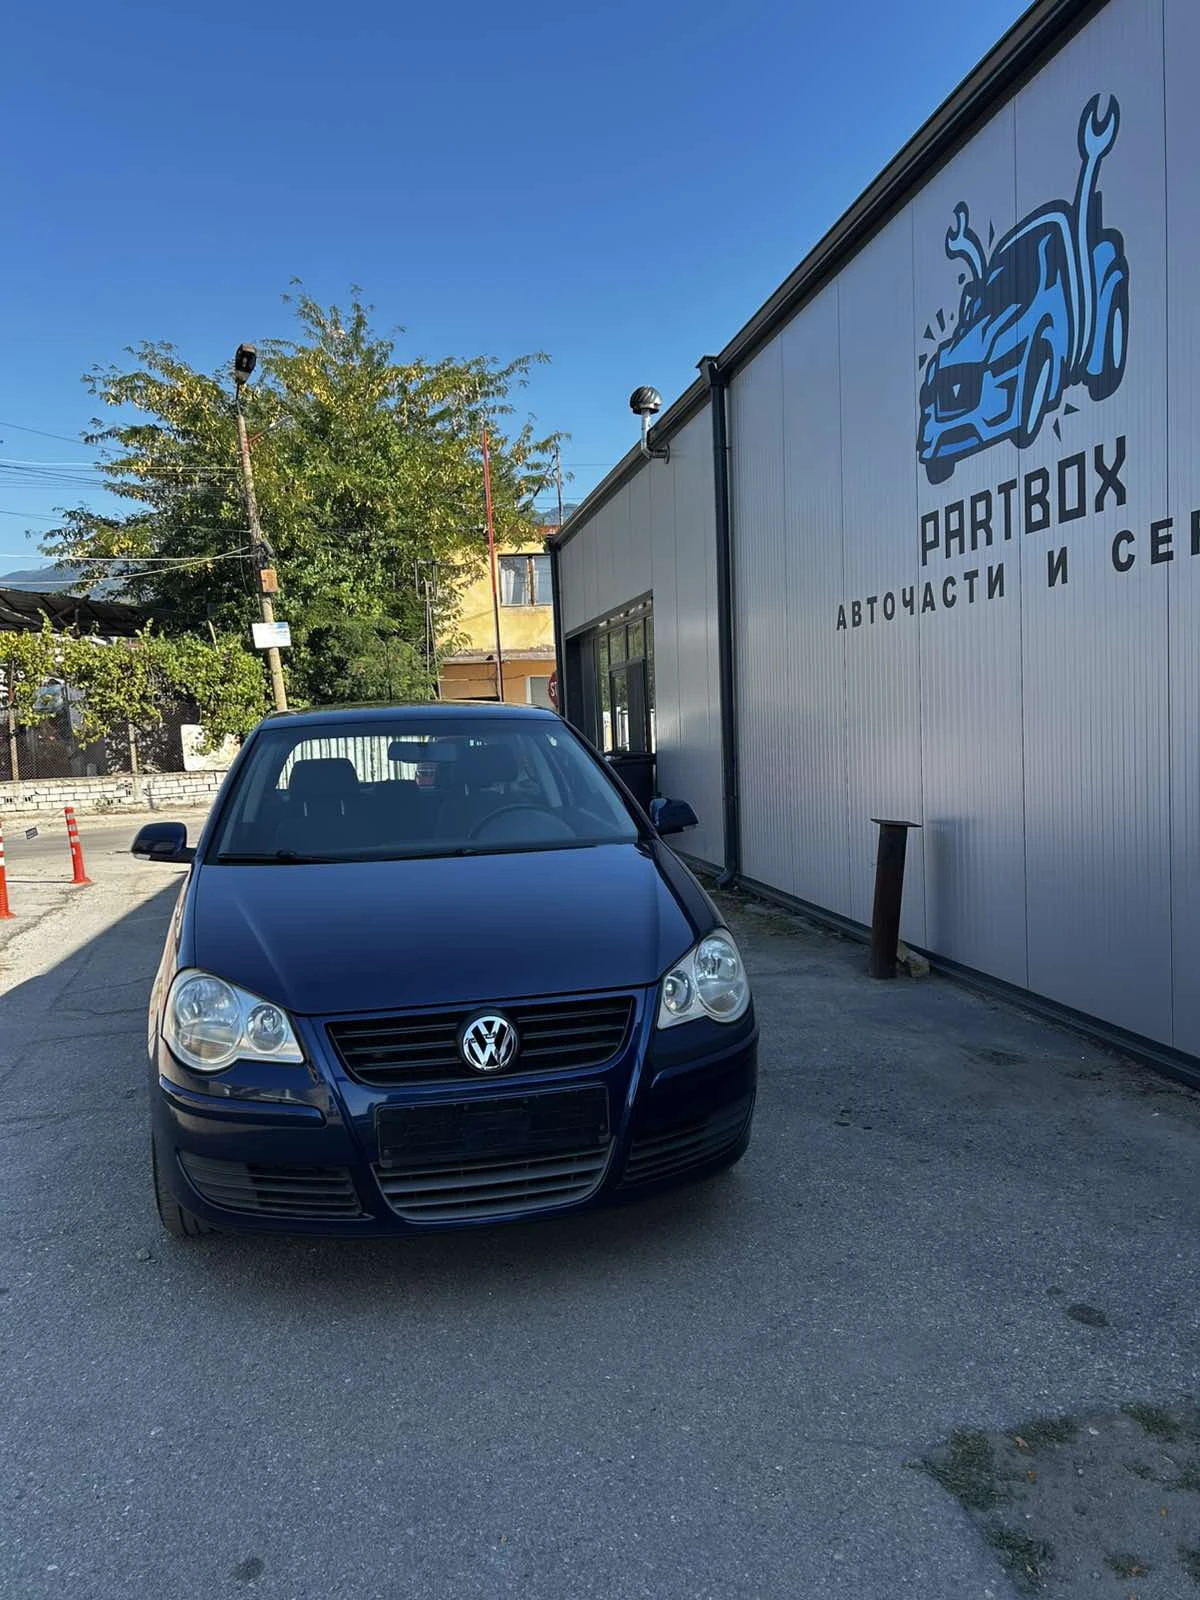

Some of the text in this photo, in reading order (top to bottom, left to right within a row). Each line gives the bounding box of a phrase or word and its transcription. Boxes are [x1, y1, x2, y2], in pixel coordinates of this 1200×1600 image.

[920, 435, 1126, 567] PARTBOX
[836, 562, 1005, 631] АВТОЧАСТИ
[1047, 546, 1068, 588] И
[463, 1015, 517, 1070] VW
